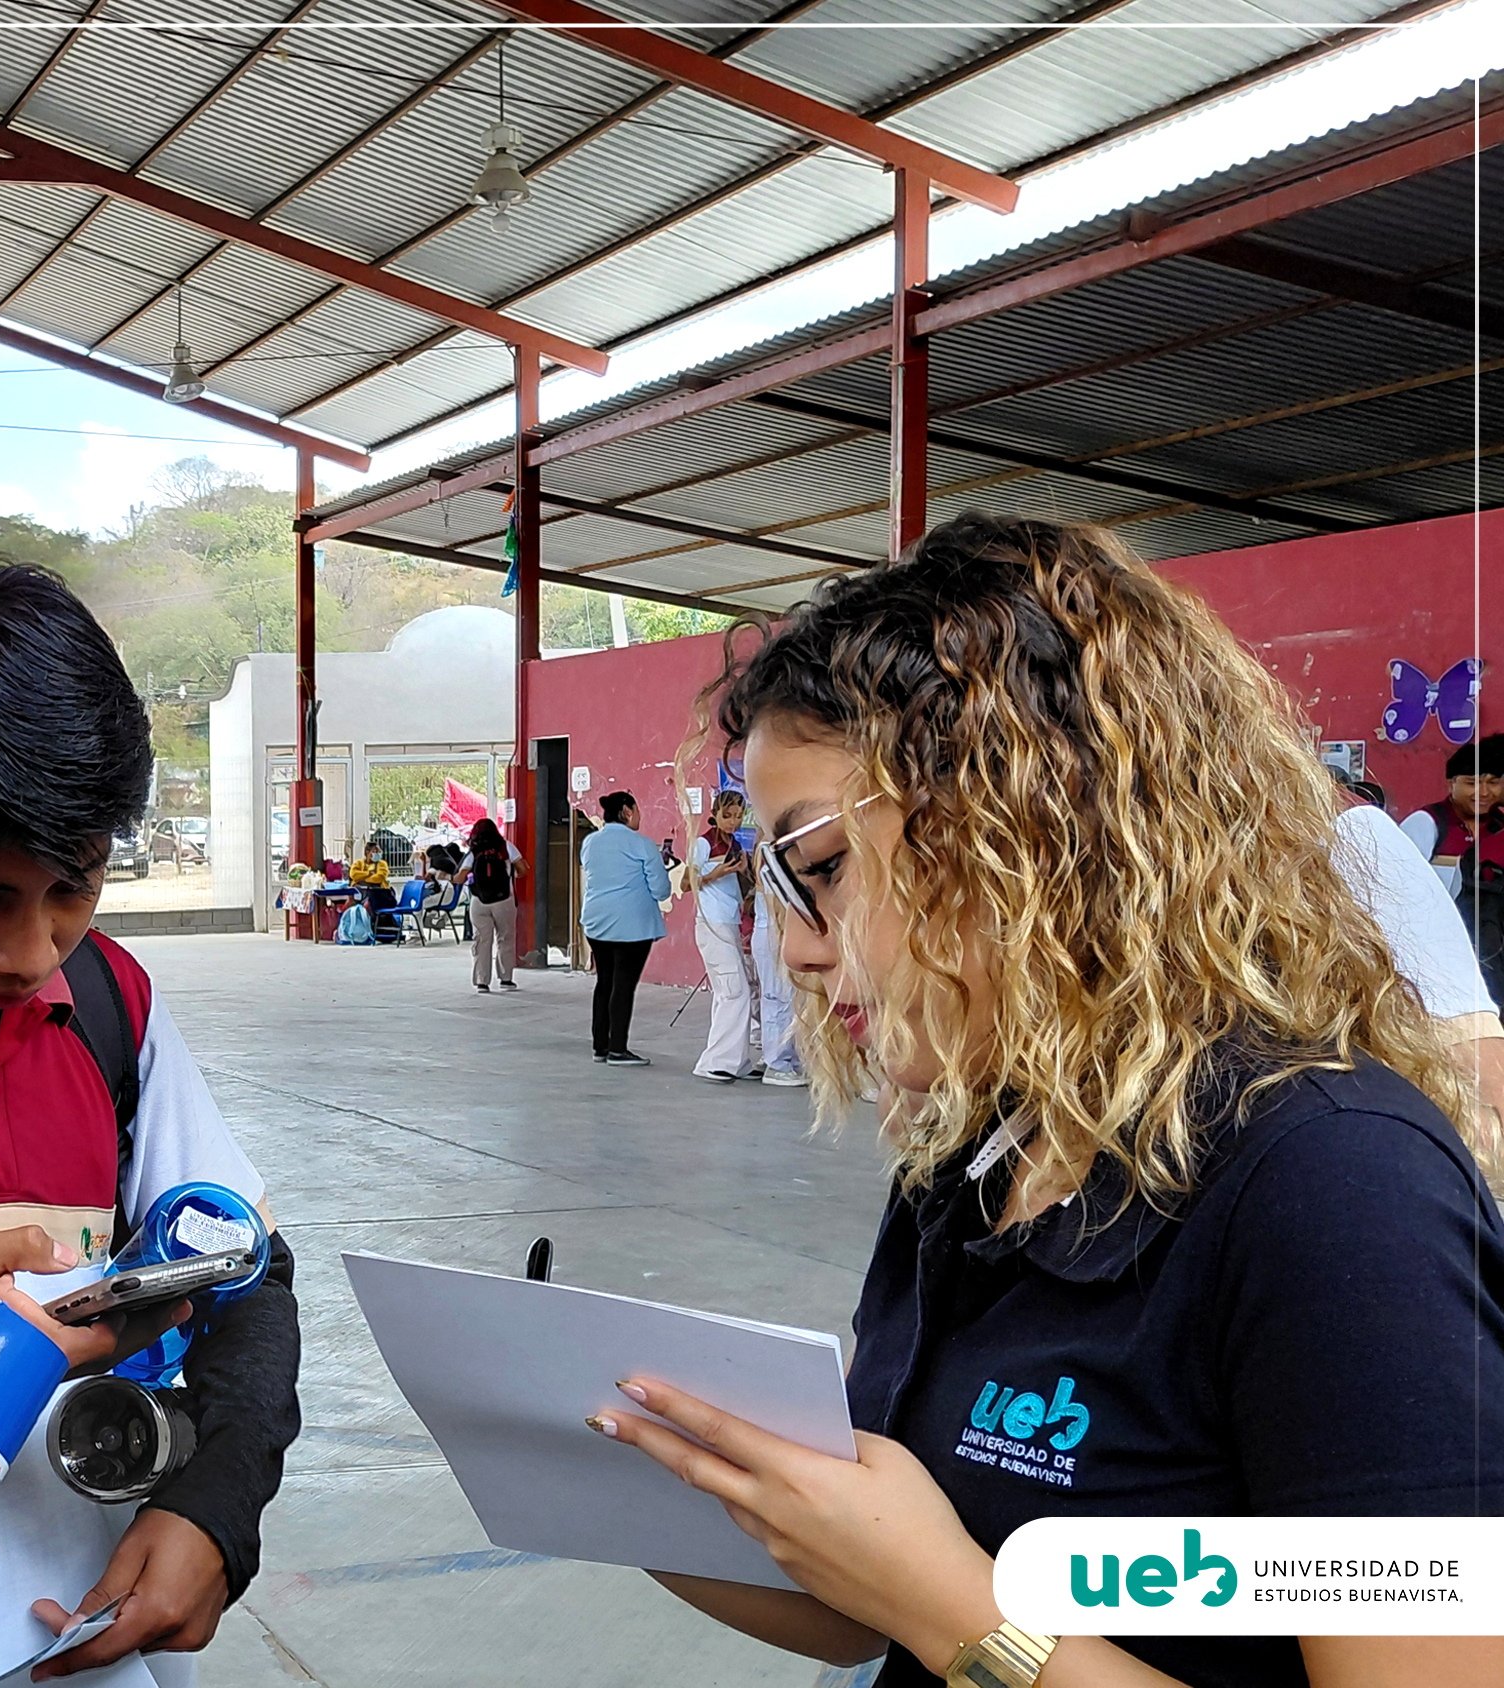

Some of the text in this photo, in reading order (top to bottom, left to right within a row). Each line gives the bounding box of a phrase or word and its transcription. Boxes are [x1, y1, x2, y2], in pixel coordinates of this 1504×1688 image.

[971, 1376, 1090, 1451] ueb
[955, 1444, 1073, 1488] ESTUDIOS BUENAVISTA
[961, 1427, 1077, 1472] UNIVERSIDAD DE
